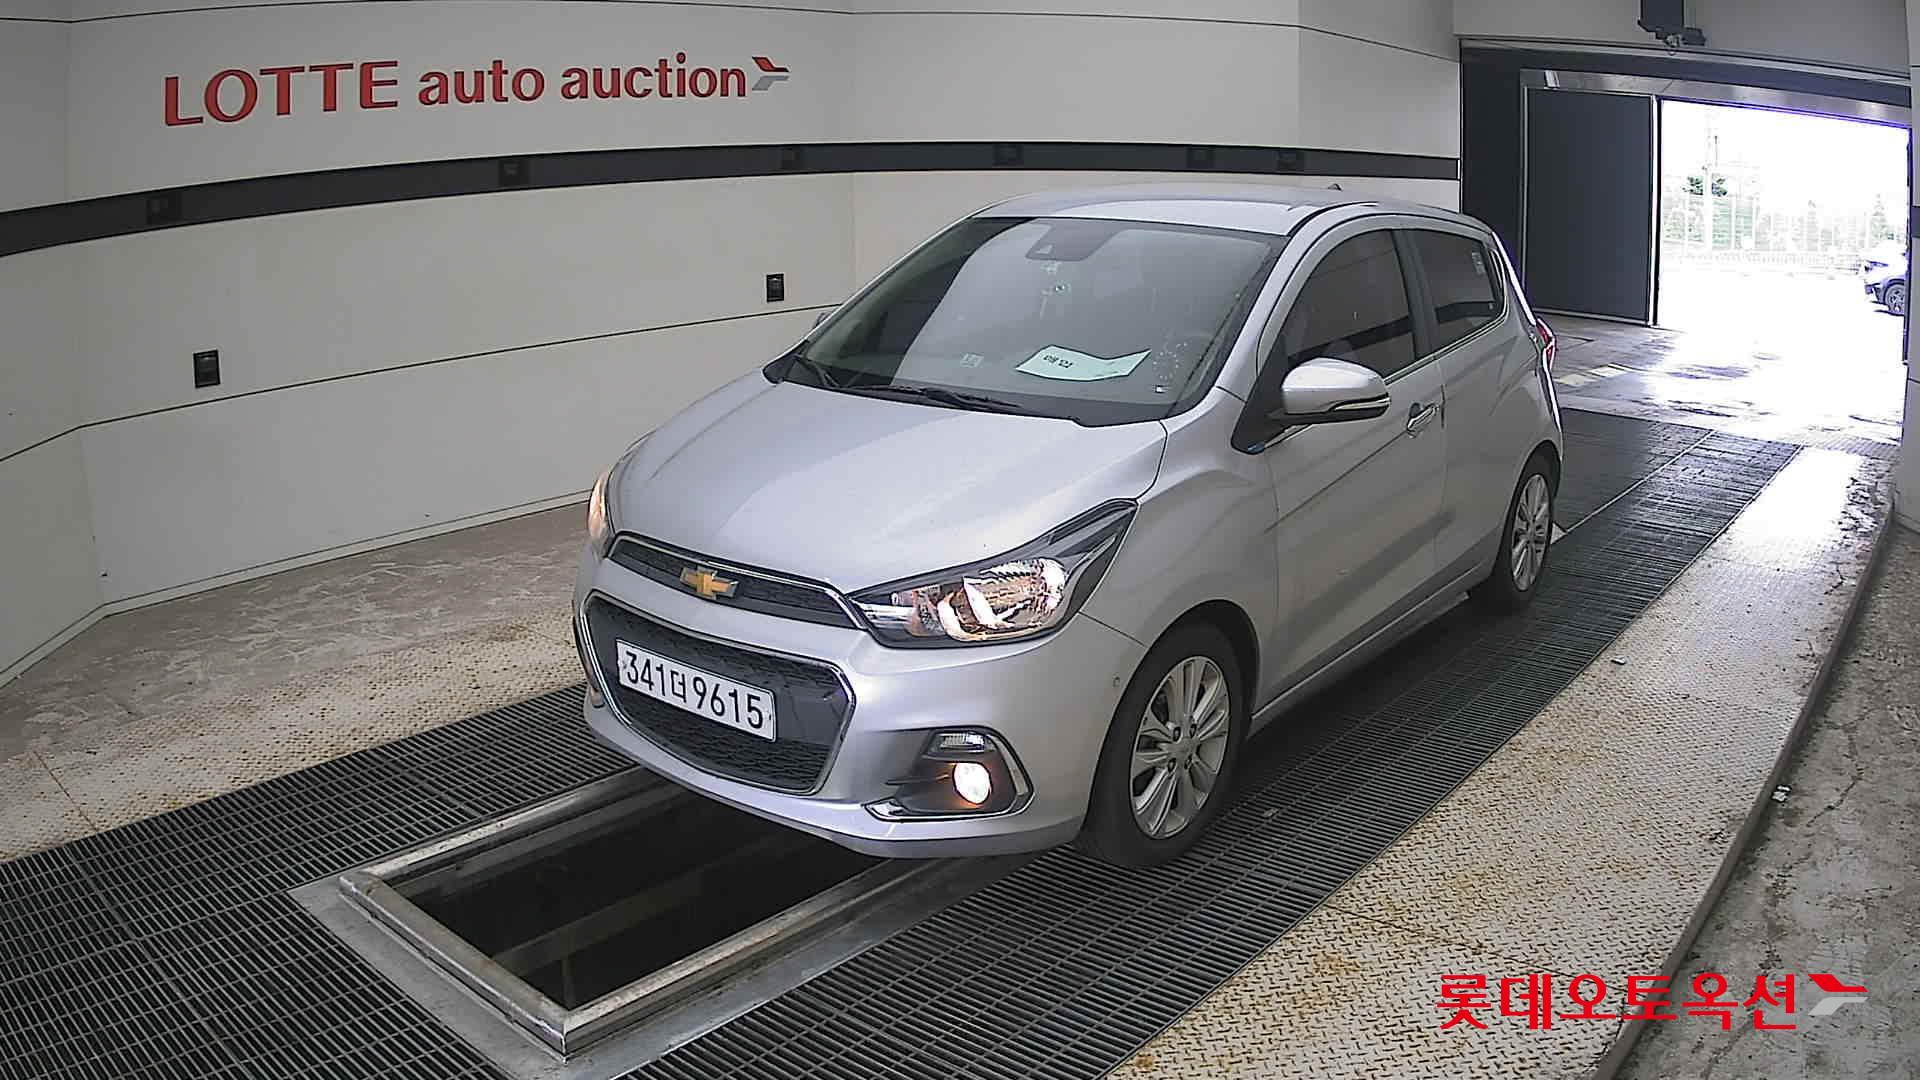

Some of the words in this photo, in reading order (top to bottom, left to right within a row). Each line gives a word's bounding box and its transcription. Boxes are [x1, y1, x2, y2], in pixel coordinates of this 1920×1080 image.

[164, 61, 398, 126] LOTTE
[418, 60, 546, 107] auto
[561, 52, 746, 100] auction
[625, 650, 764, 730] 341더9615
